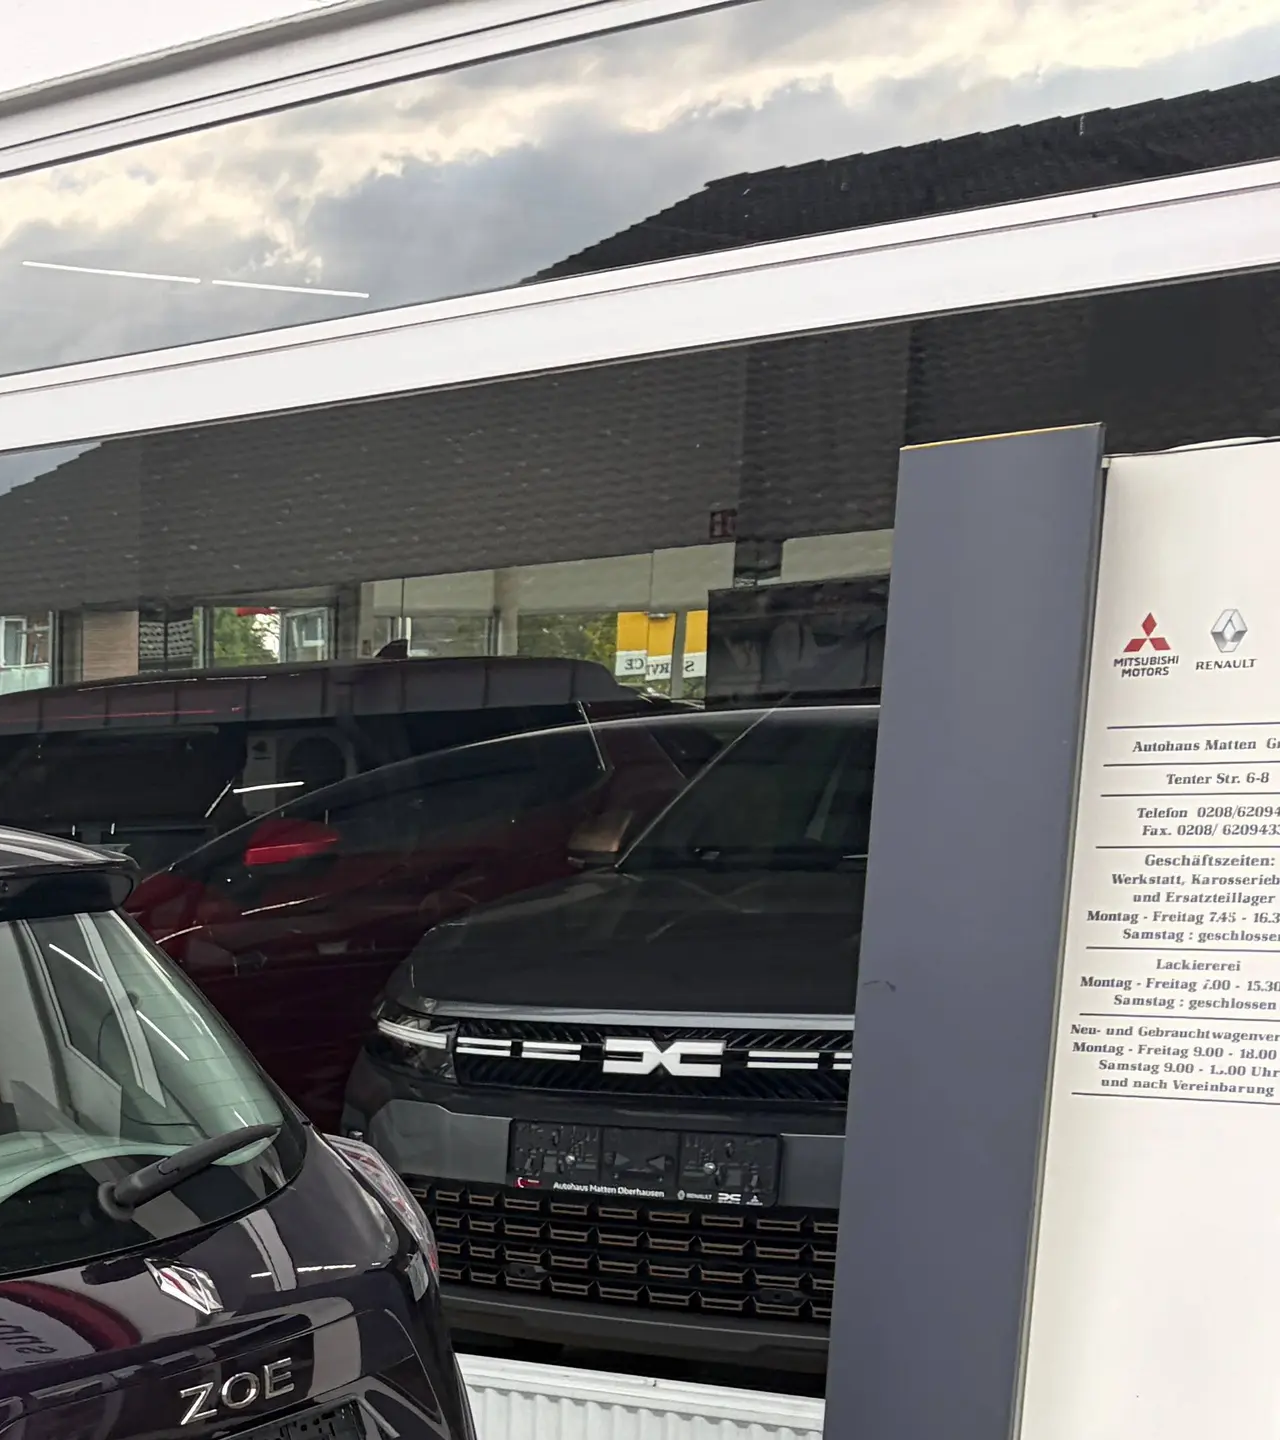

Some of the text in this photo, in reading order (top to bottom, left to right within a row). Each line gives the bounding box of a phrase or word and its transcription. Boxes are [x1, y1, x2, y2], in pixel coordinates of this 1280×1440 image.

[1113, 655, 1179, 667] MITSUBISHI
[1196, 658, 1257, 670] RENAULT
[1121, 667, 1169, 677] MOTORS
[1133, 737, 1280, 752] Autohaus Matten G
[1166, 772, 1270, 785] Tenter Str. 6-8
[1137, 806, 1188, 819] Telefon
[1142, 825, 1172, 836] Fax.
[1144, 853, 1276, 867] Geschäftszeiten:
[1112, 873, 1185, 886] Werkstatt,
[1133, 892, 1276, 906] und Ersatzteillager
[1087, 910, 1139, 925] Montag
[1152, 911, 1204, 926] Freitag
[1123, 928, 1184, 943] Samstag
[1156, 958, 1241, 971] Lackiererei
[1080, 976, 1132, 991] Montag
[1146, 977, 1197, 992] Freitag
[1113, 994, 1175, 1010] Samstag
[1188, 996, 1276, 1010] geschlossen
[1070, 1024, 1101, 1035] Neu-
[1106, 1026, 1133, 1036] und
[1072, 1041, 1124, 1056] Montag
[1137, 1044, 1189, 1058] Freitag
[1193, 1046, 1224, 1057] 9.00
[1098, 1059, 1160, 1074] Samstag
[1163, 1062, 1194, 1073] 9.00
[1101, 1077, 1275, 1097] und nach Vereinbarung
[553, 1181, 588, 1192] Autohaus
[590, 1184, 616, 1194] Matten
[618, 1187, 664, 1198] Oberhausen
[180, 1357, 295, 1426] ZOE
